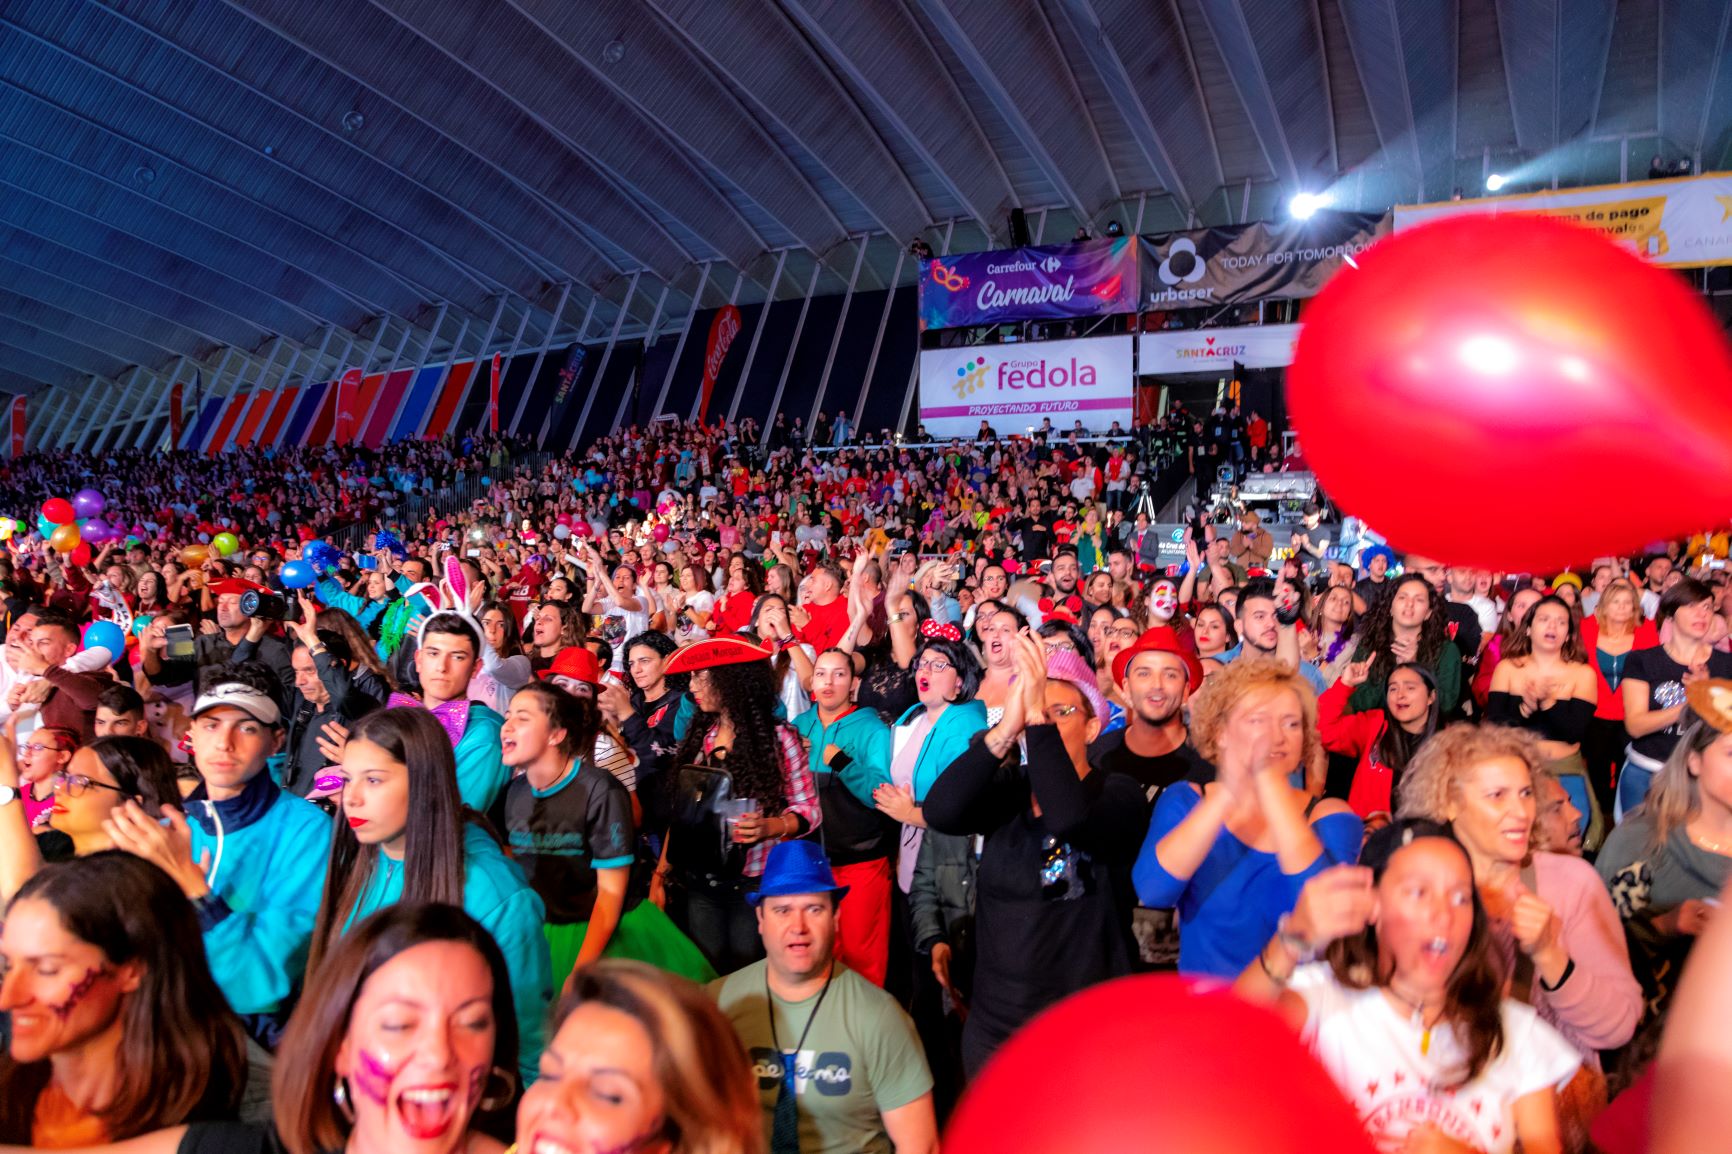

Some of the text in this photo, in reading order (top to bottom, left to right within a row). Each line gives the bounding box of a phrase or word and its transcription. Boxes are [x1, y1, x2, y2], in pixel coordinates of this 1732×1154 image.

[1585, 211, 1604, 221] de
[1609, 207, 1650, 220] pago
[1221, 241, 1378, 269] TODAY FOR TOMORROW
[987, 260, 1037, 275] Carrefour
[976, 274, 1075, 311] Carnaval
[1150, 286, 1215, 304] urbaser
[1010, 359, 1038, 369] Grupo
[998, 357, 1097, 390] fedola
[968, 401, 1079, 416] PROYECTANDO FUTURO
